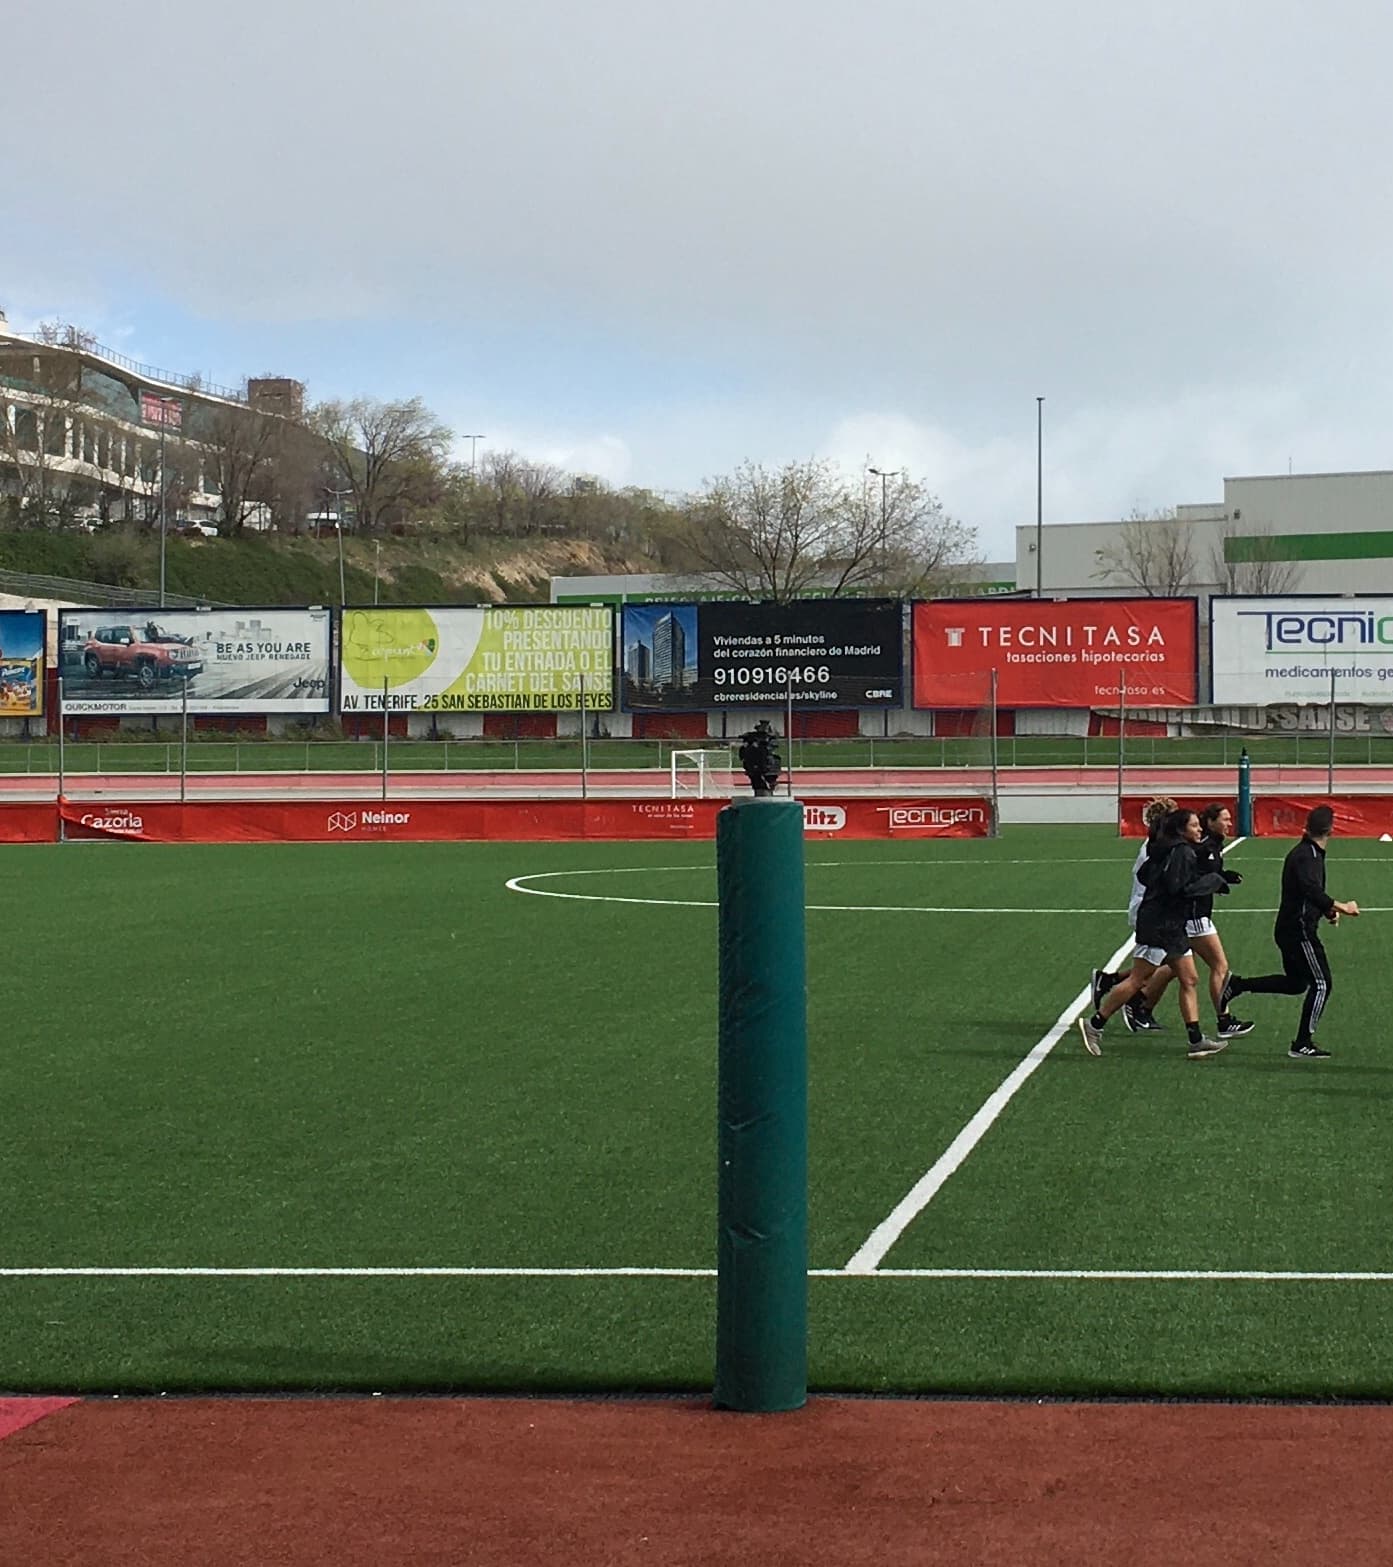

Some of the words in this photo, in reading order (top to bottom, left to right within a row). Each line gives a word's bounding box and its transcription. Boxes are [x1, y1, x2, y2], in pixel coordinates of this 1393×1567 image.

[486, 611, 519, 630] 10%
[524, 610, 612, 629] DESCUENTO
[503, 630, 611, 650] PRESENTANDO
[713, 636, 763, 645] Viviendas
[765, 637, 771, 645] a
[774, 635, 781, 644] 5
[783, 635, 825, 644] minutos
[978, 626, 1165, 647] TECNITASA
[217, 643, 233, 653] BE
[237, 643, 253, 653] AS
[257, 643, 282, 653] YOU
[286, 642, 311, 653] ARE
[713, 649, 730, 658] del
[732, 648, 773, 657] corazón
[775, 647, 827, 656] financiero
[829, 646, 842, 655] de
[844, 645, 881, 655] Madrid
[482, 652, 500, 671] TU
[506, 651, 576, 671] ENTRADA
[580, 651, 591, 671] O
[594, 651, 611, 671] EL
[1007, 650, 1077, 663] tasaciones
[1081, 648, 1165, 665] hipotecarias
[714, 666, 830, 685] 910916466
[1265, 665, 1373, 678] medicamentos
[292, 677, 325, 690] Jeep
[466, 673, 526, 692] CARNET
[530, 672, 557, 692] DEL
[562, 672, 611, 691] SANSE
[344, 695, 361, 710] AV.
[424, 694, 439, 709] 25
[441, 694, 465, 709] SAN
[467, 694, 529, 709] SEBASTIAN
[533, 694, 548, 709] DE
[551, 694, 572, 709] LOS
[576, 693, 611, 709] REYES
[865, 690, 893, 698] CBRE
[65, 703, 127, 711] QUICKMOTOR
[1283, 705, 1370, 731] SANSE
[361, 810, 411, 824] Neinor
[632, 804, 694, 813] TECNITASA
[876, 806, 984, 829] Tecnigen
